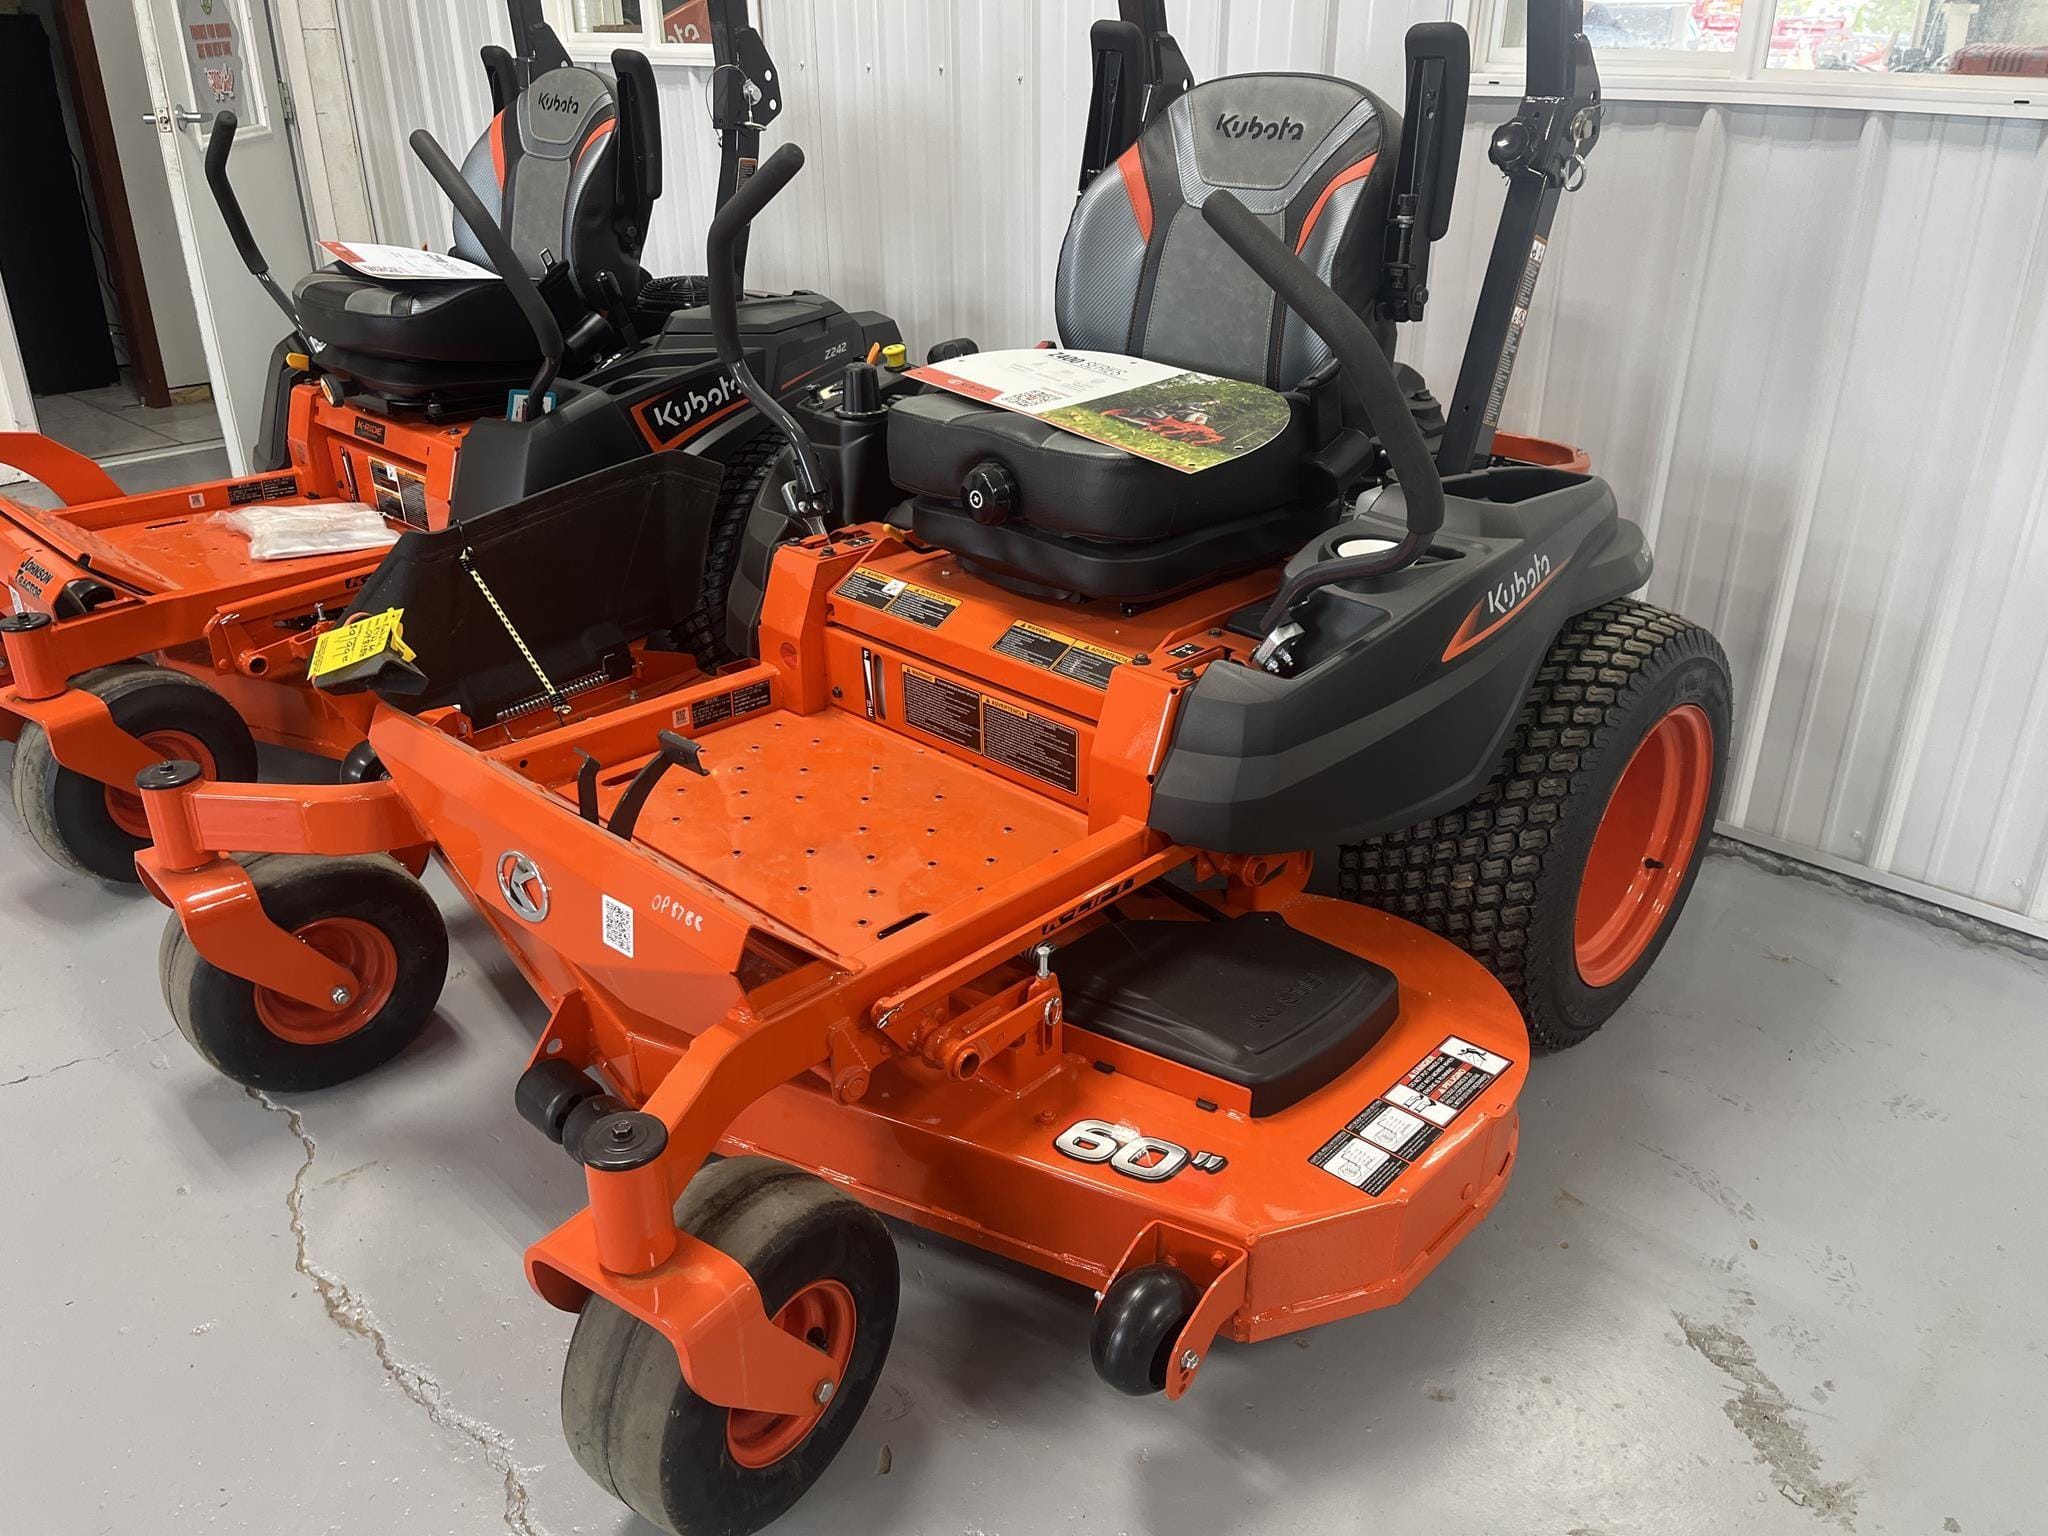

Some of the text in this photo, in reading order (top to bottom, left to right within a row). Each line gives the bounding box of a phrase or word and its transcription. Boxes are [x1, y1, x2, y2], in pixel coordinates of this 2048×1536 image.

[538, 91, 579, 115] Kubota
[1215, 113, 1304, 140] Kubota
[824, 342, 847, 360] Z242
[357, 421, 384, 436] K-RIDE
[20, 556, 54, 584] JOHNSON
[1487, 553, 1551, 614] Kubota
[1026, 624, 1051, 635] WARNING
[863, 650, 870, 659] F
[867, 707, 874, 717] E
[1042, 877, 1134, 935] K-LIFT
[1411, 1055, 1436, 1075] DANGER
[1441, 1068, 1467, 1089] PELIGRO
[1053, 1118, 1228, 1184] 60"
